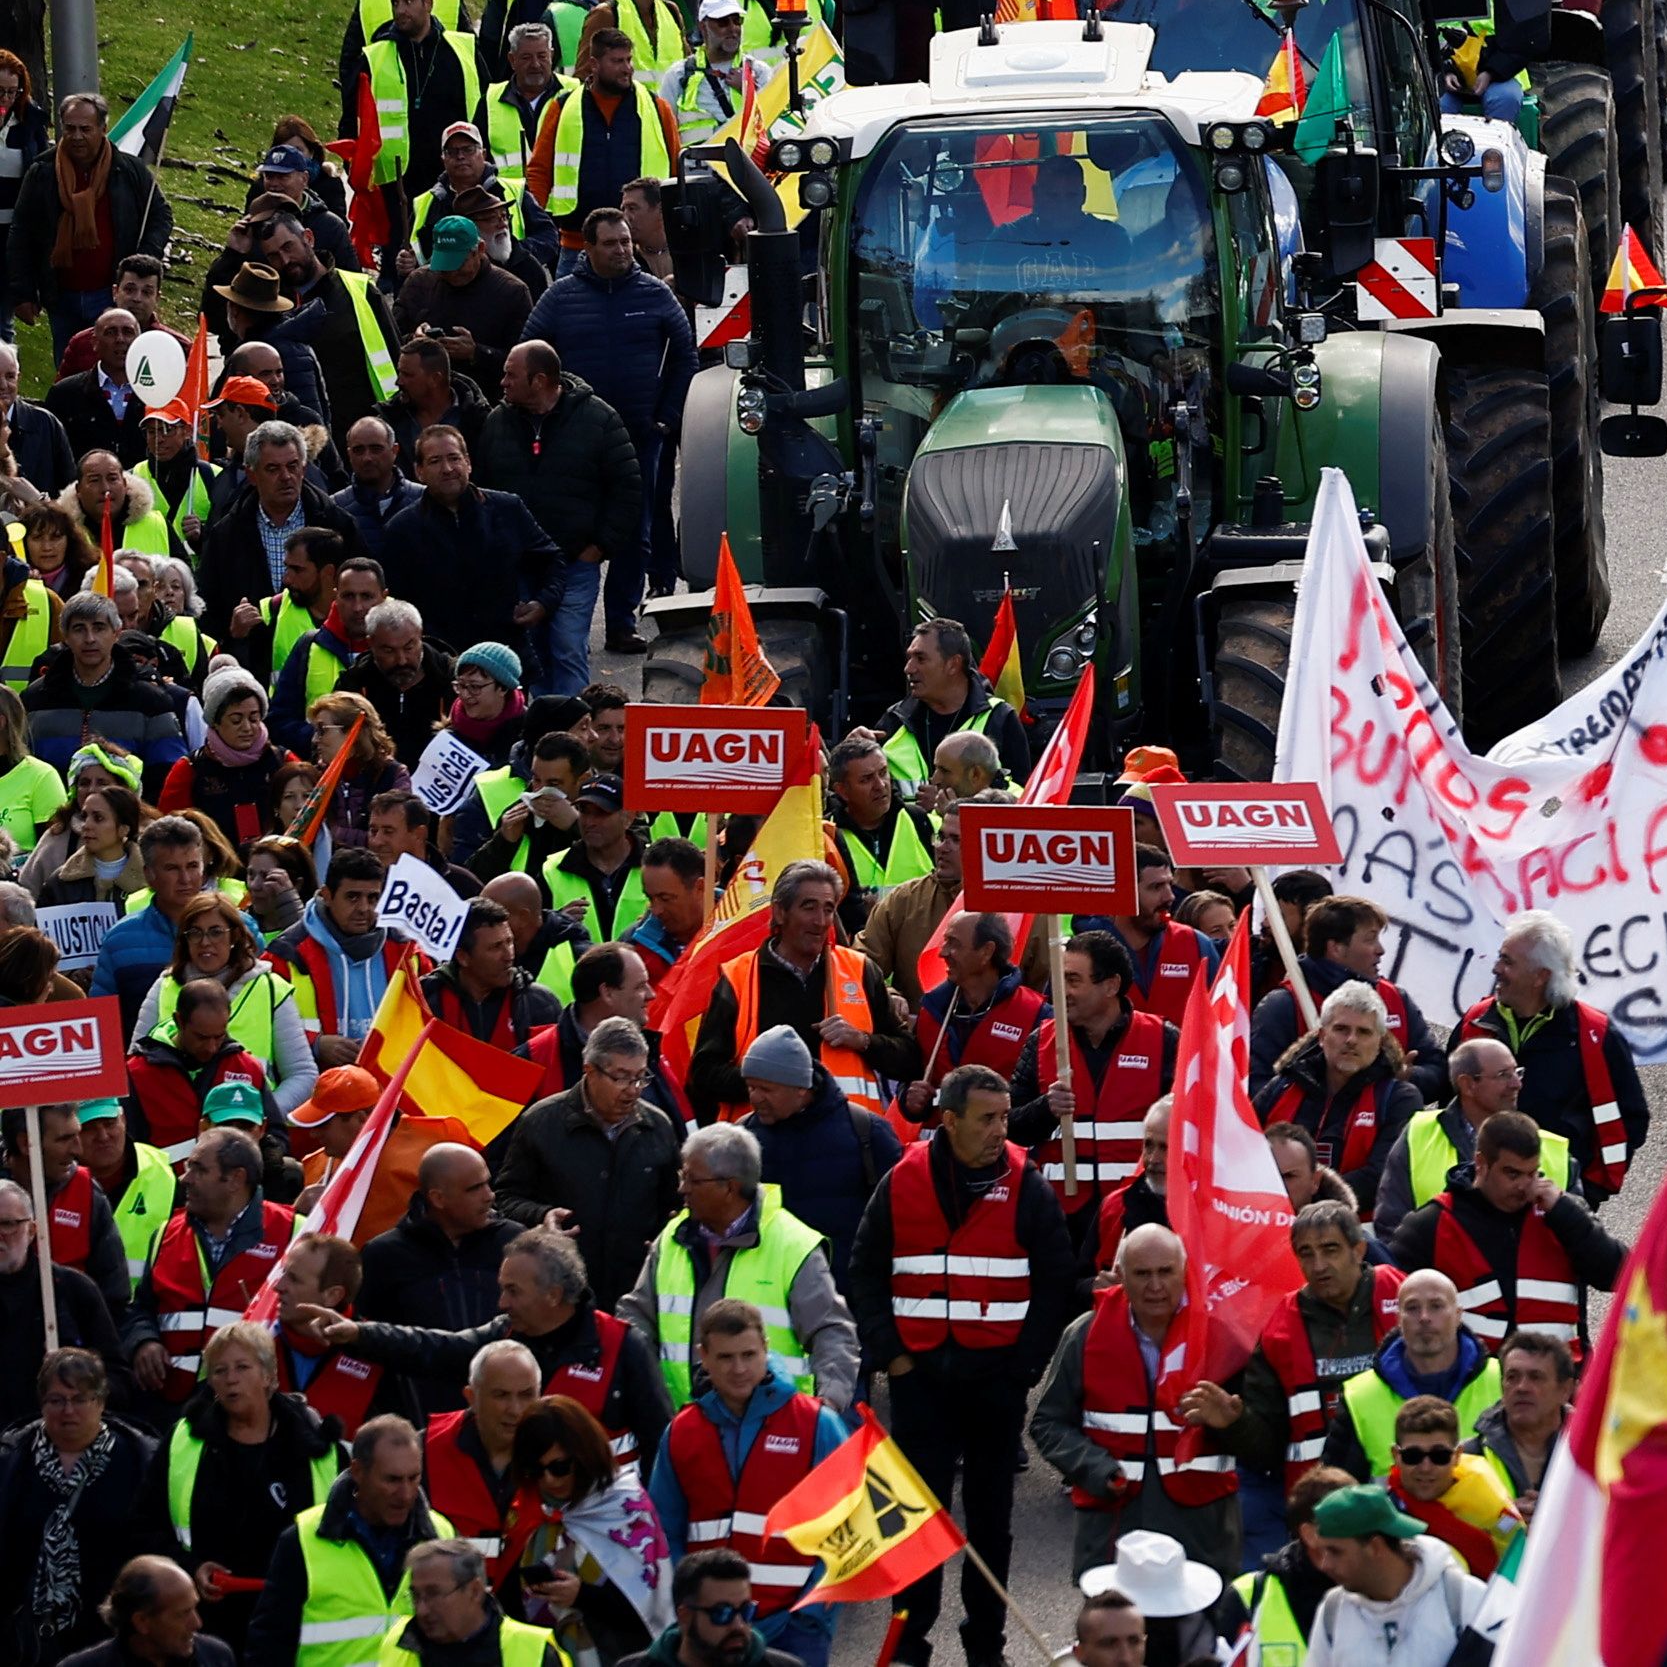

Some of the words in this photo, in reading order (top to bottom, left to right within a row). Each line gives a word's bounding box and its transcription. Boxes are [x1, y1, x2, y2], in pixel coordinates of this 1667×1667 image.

[650, 732, 779, 764] UAGN
[418, 741, 475, 809] Jusicia!
[1181, 804, 1307, 827] UAGN
[986, 833, 1110, 865] UAGN
[382, 881, 462, 948] Basta!
[0, 1021, 94, 1060] AGN
[993, 1022, 1022, 1038] UAGN
[1119, 1054, 1149, 1065] UAGN
[1211, 1199, 1271, 1226] UNIÓN
